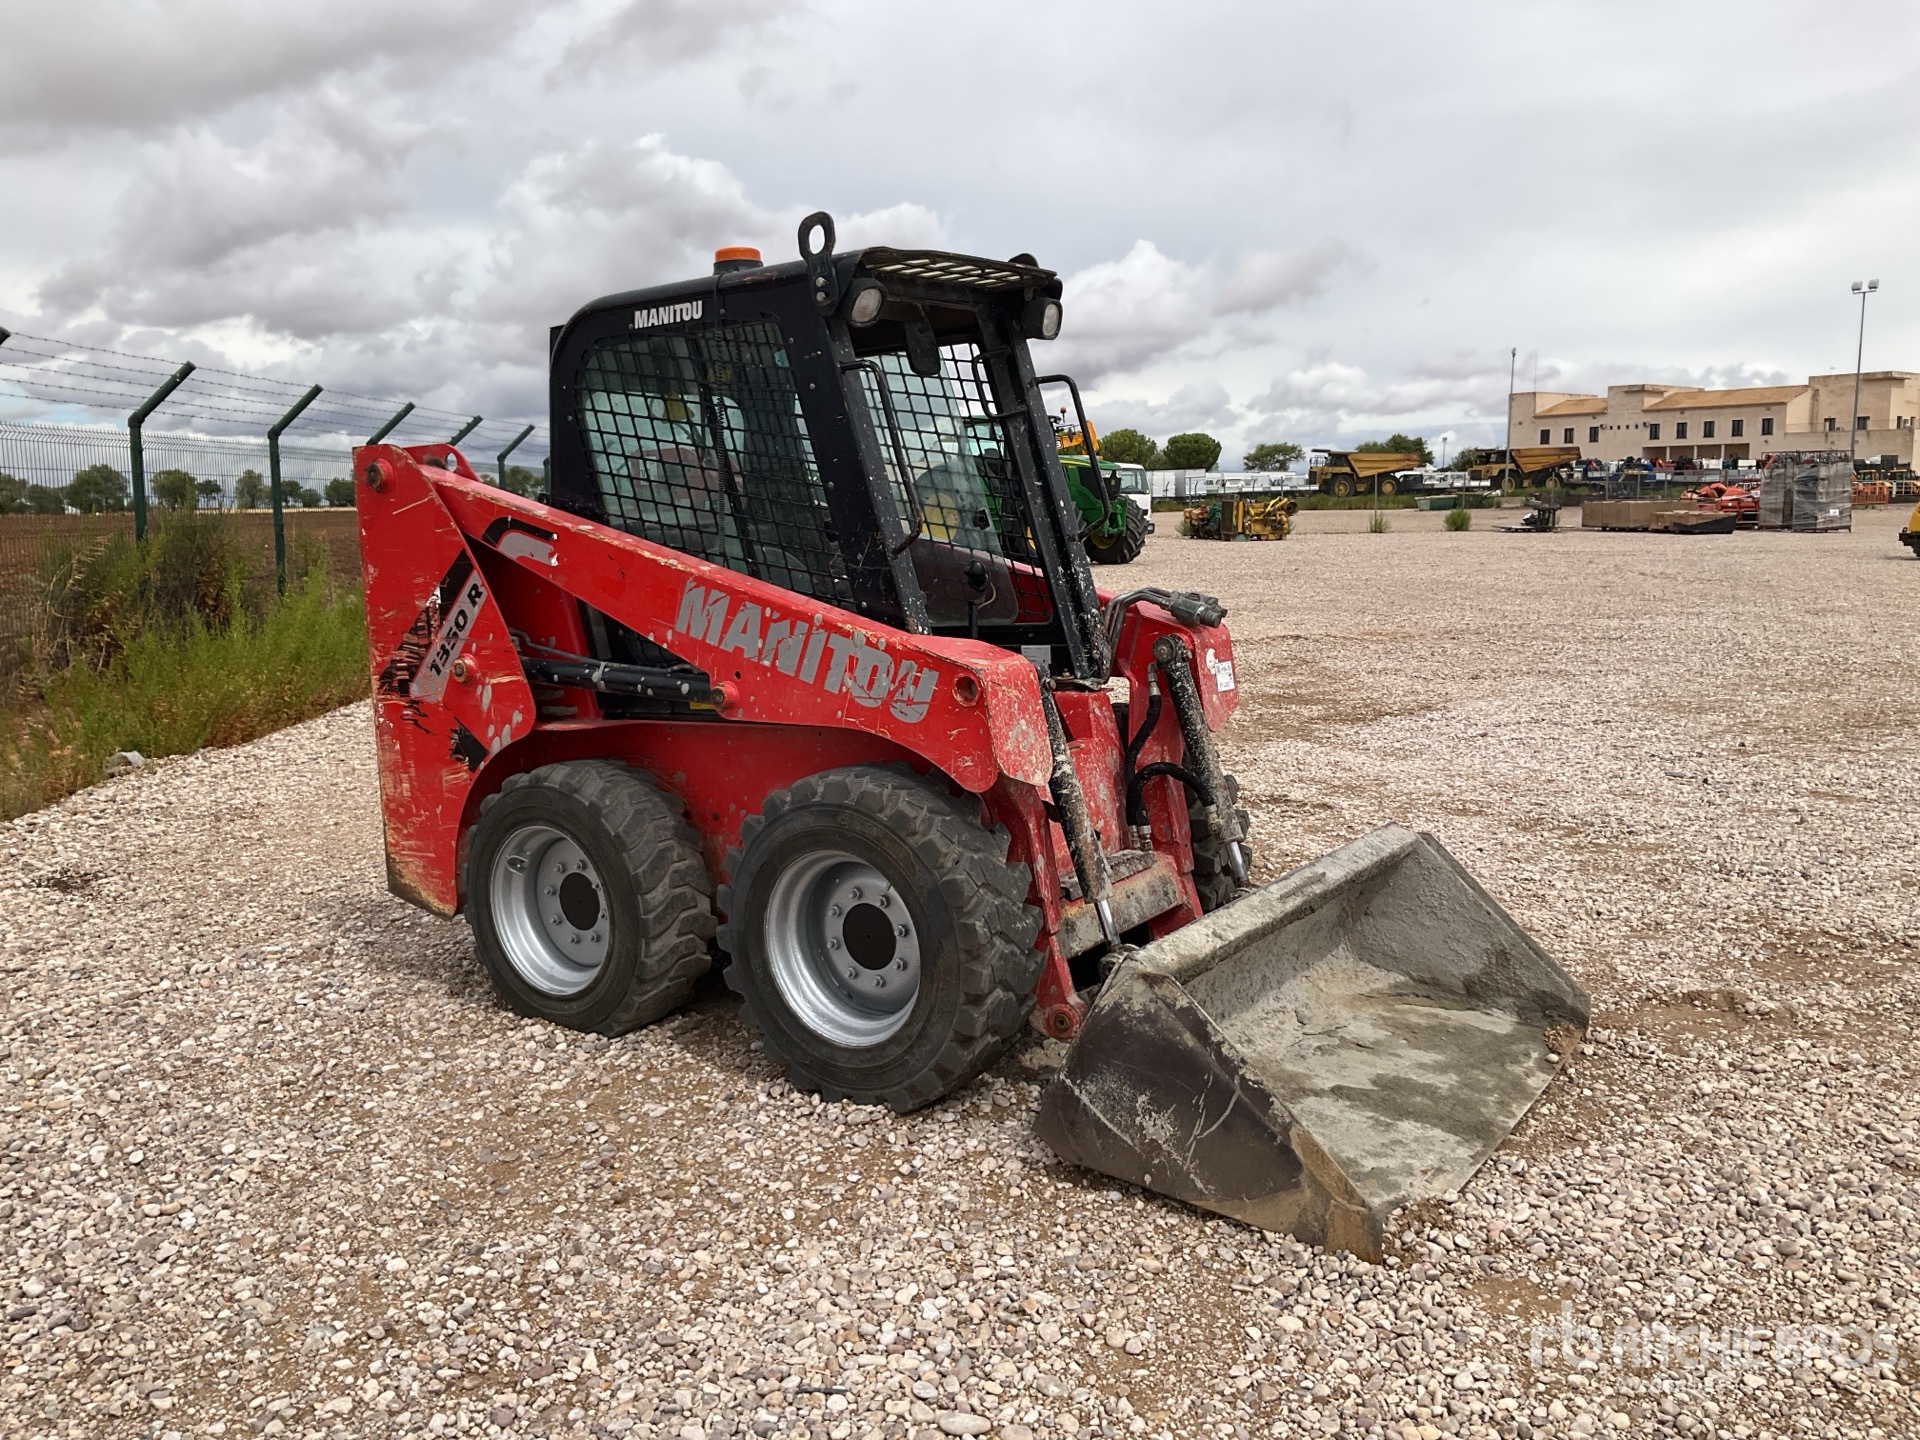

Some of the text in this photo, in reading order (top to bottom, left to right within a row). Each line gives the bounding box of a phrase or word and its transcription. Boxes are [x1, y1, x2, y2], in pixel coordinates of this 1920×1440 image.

[634, 300, 703, 330] MANITOU
[430, 583, 484, 676] 1350 R
[675, 579, 939, 724] MANITOU
